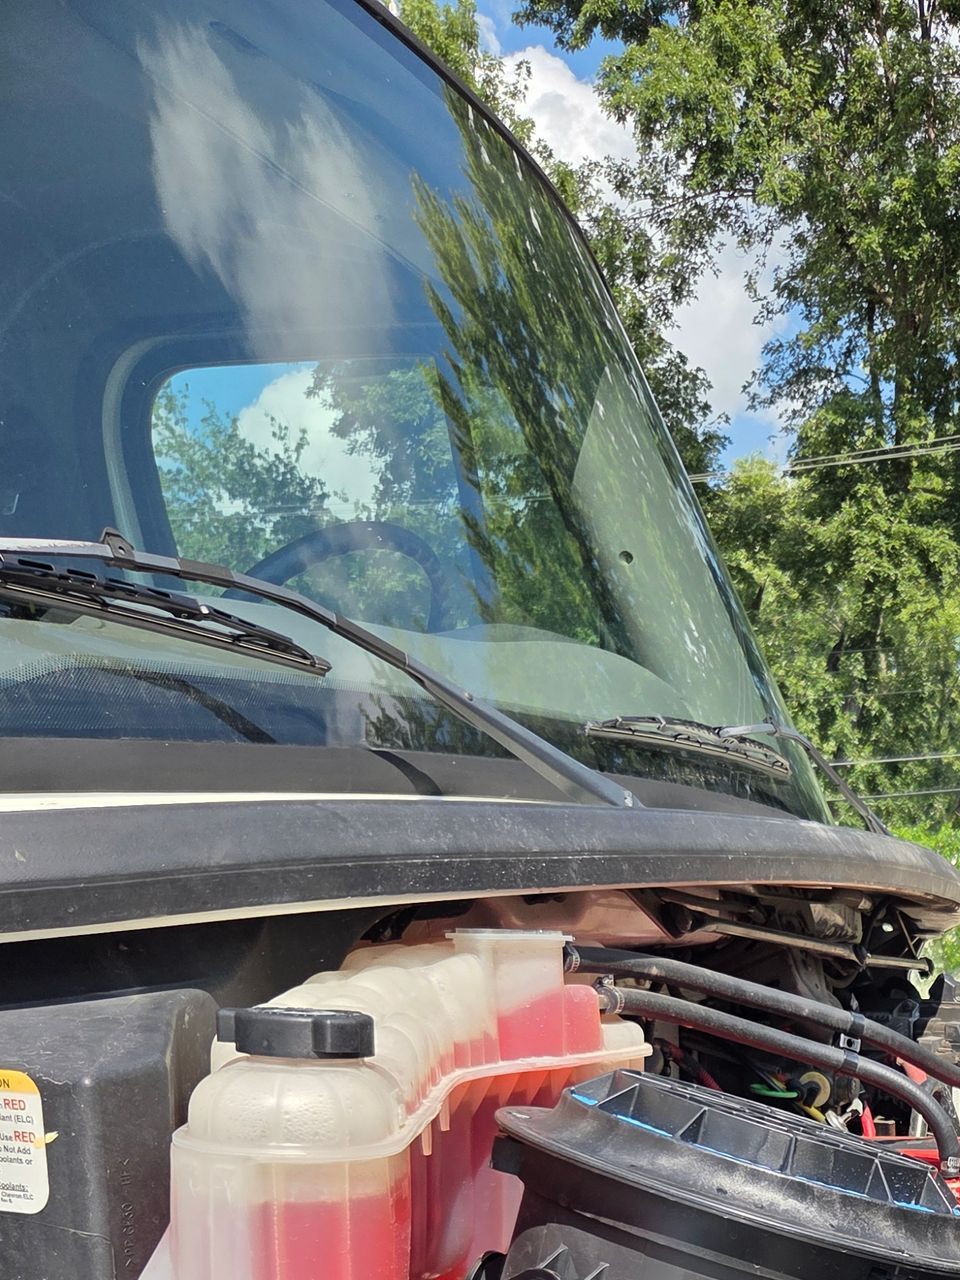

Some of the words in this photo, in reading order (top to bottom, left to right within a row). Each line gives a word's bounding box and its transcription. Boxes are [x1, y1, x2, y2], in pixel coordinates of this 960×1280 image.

[3, 1098, 26, 1111] RED
[0, 1114, 12, 1122] lant
[14, 1114, 34, 1125] (ELC)
[0, 1132, 13, 1142] Use
[14, 1130, 36, 1143] RED
[3, 1145, 16, 1153] Not
[0, 1156, 24, 1164] oolants
[0, 1182, 29, 1192] oolants:
